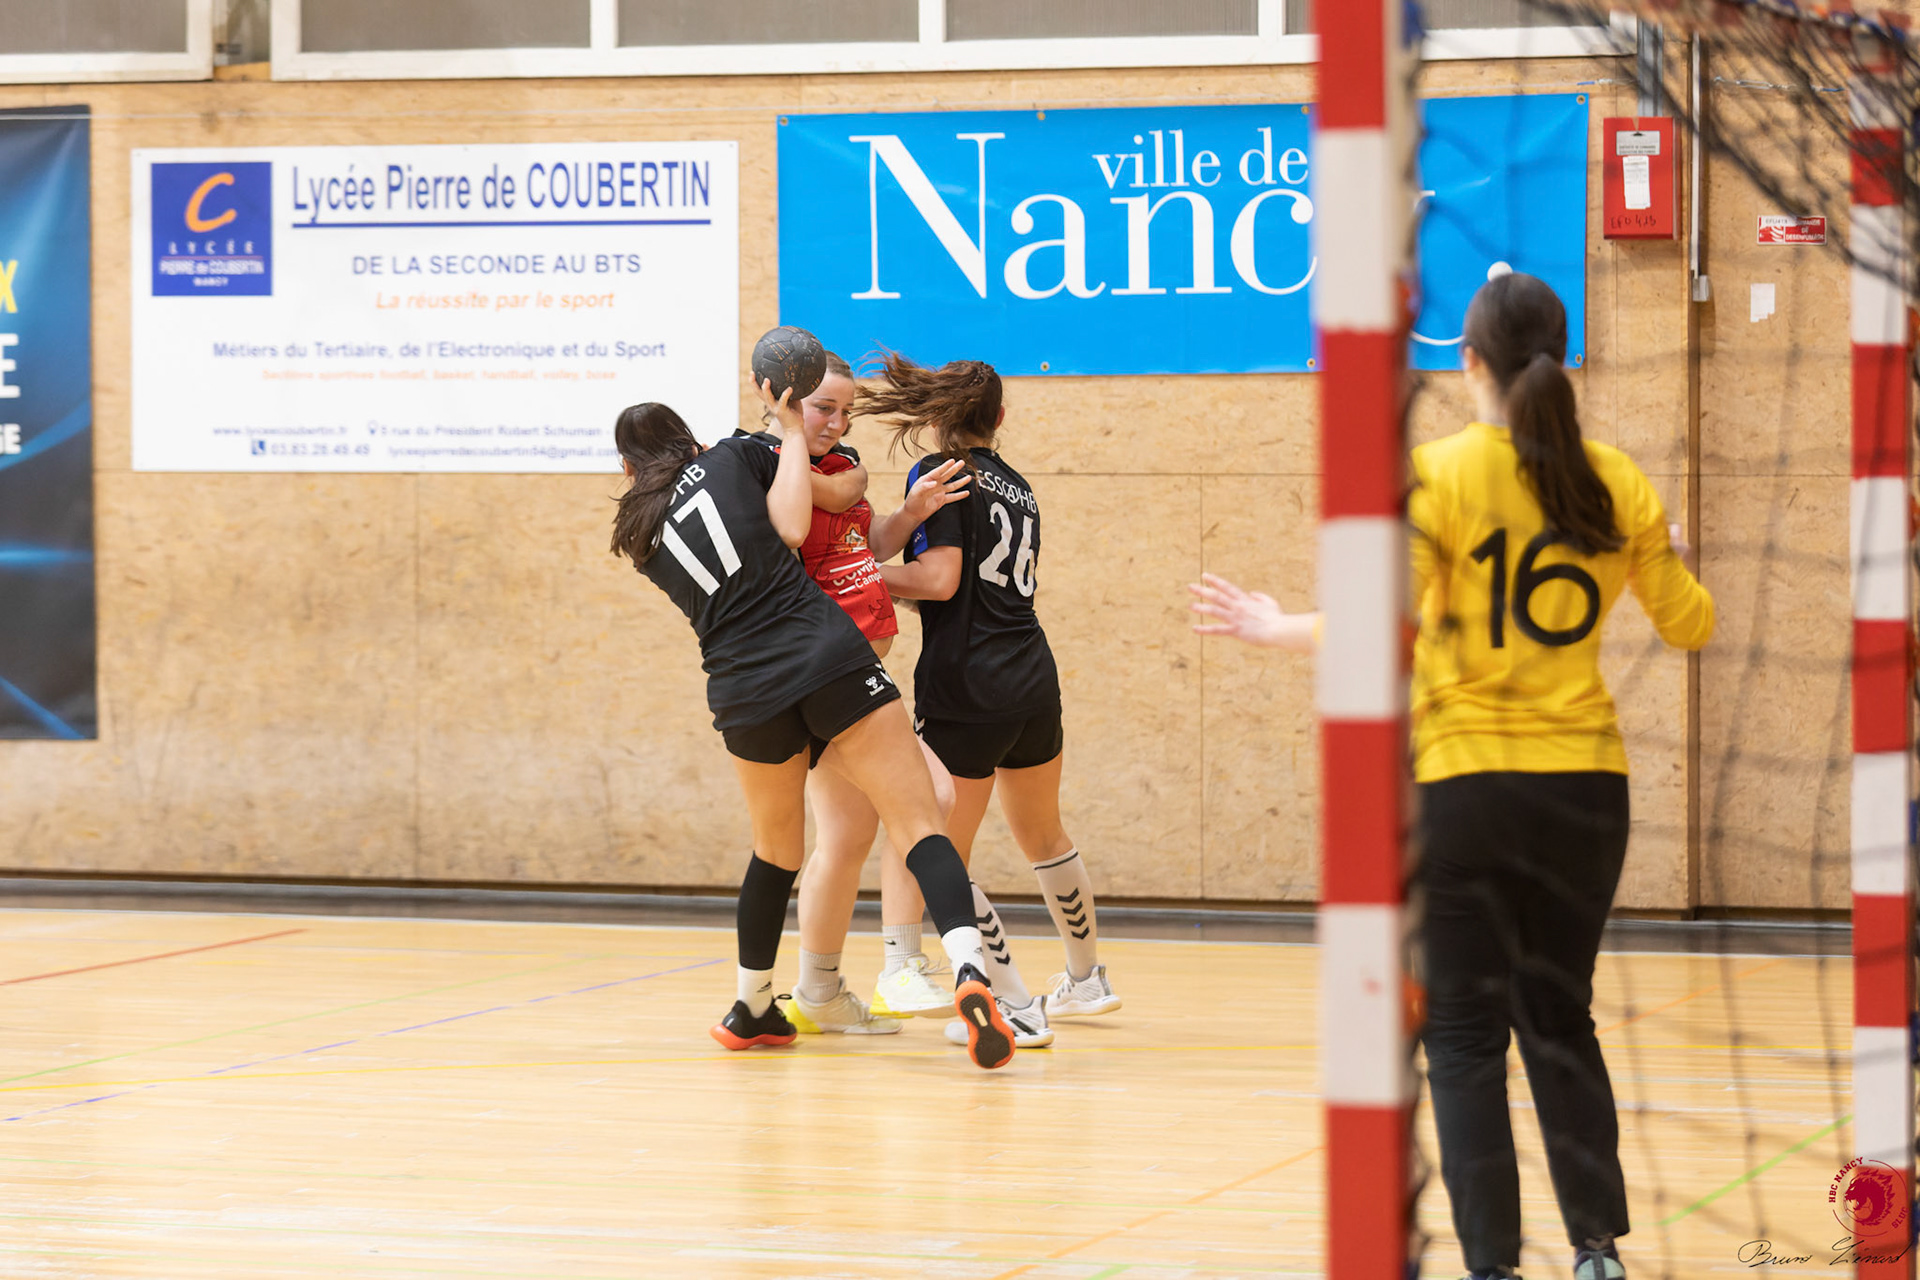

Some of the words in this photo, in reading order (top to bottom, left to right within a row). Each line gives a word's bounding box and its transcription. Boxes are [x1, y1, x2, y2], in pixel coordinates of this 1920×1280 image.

[1092, 130, 1221, 188] ville
[1239, 127, 1309, 184] de
[292, 165, 376, 224] Lycée
[387, 164, 470, 209] Pierre
[482, 163, 516, 208] de
[527, 161, 710, 208] COUBERTIN
[353, 256, 383, 274] DE
[392, 256, 422, 274] LA
[429, 255, 545, 274] SECONDE
[553, 255, 586, 273] AU
[595, 254, 641, 273] BTS
[849, 132, 1505, 346] Nanc
[375, 292, 400, 309] La
[407, 290, 489, 309] réussite
[494, 294, 529, 312] par
[535, 290, 554, 308] le
[559, 292, 615, 312] sport
[213, 341, 278, 357] Métiers
[285, 342, 308, 357] du
[314, 341, 393, 358] Tertiaire,
[399, 341, 420, 356] de
[562, 343, 578, 357] et
[585, 342, 608, 356] du
[615, 341, 665, 359] Sport
[0, 423, 21, 455] E
[651, 488, 743, 597] 17
[978, 501, 1035, 598] 26
[1470, 527, 1600, 648] 16
